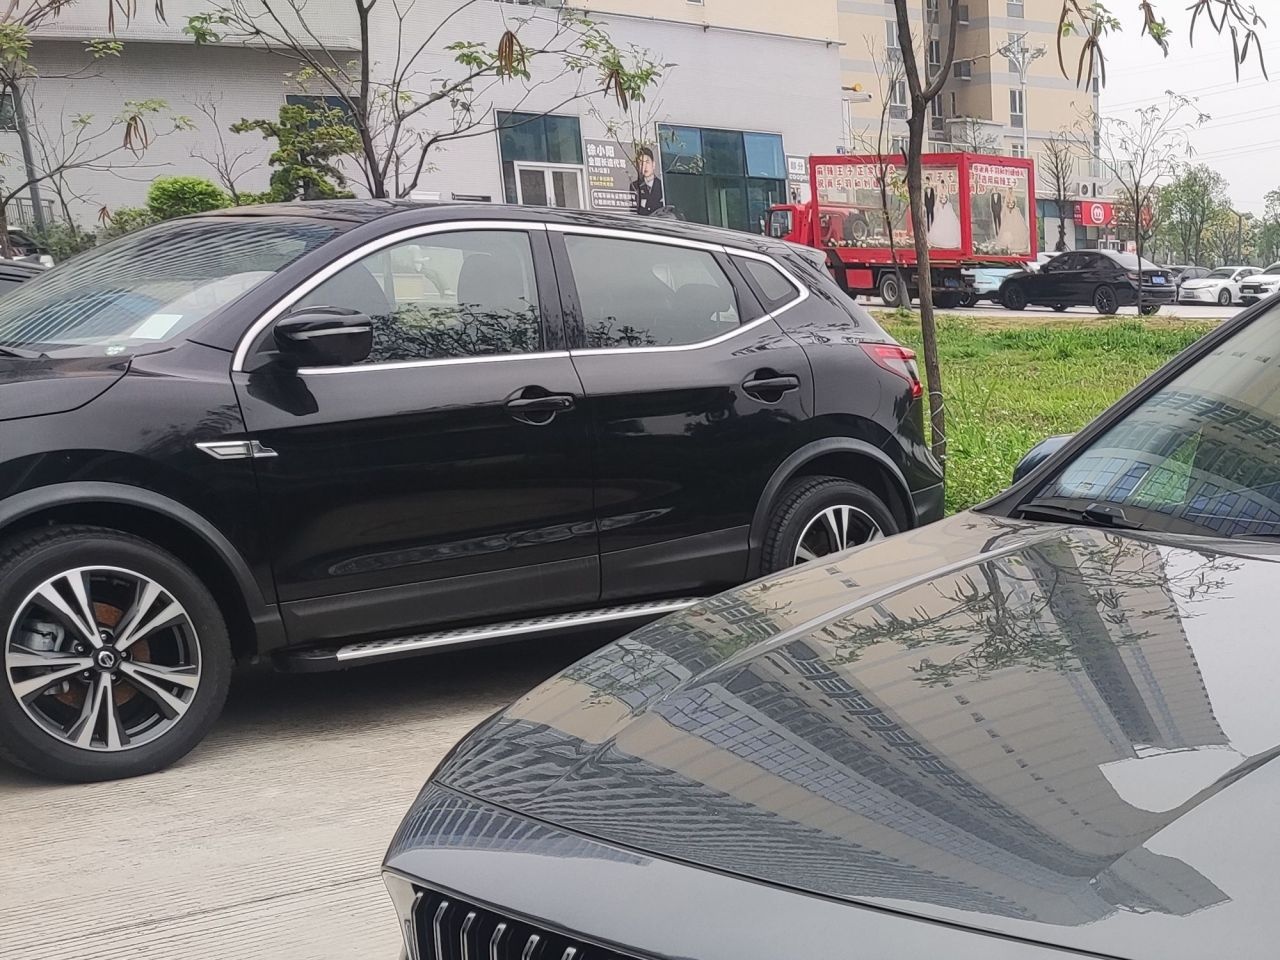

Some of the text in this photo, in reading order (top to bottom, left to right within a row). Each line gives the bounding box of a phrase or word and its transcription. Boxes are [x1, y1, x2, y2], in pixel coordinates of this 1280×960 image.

[816, 165, 895, 176] 麻辣王子正宗条
